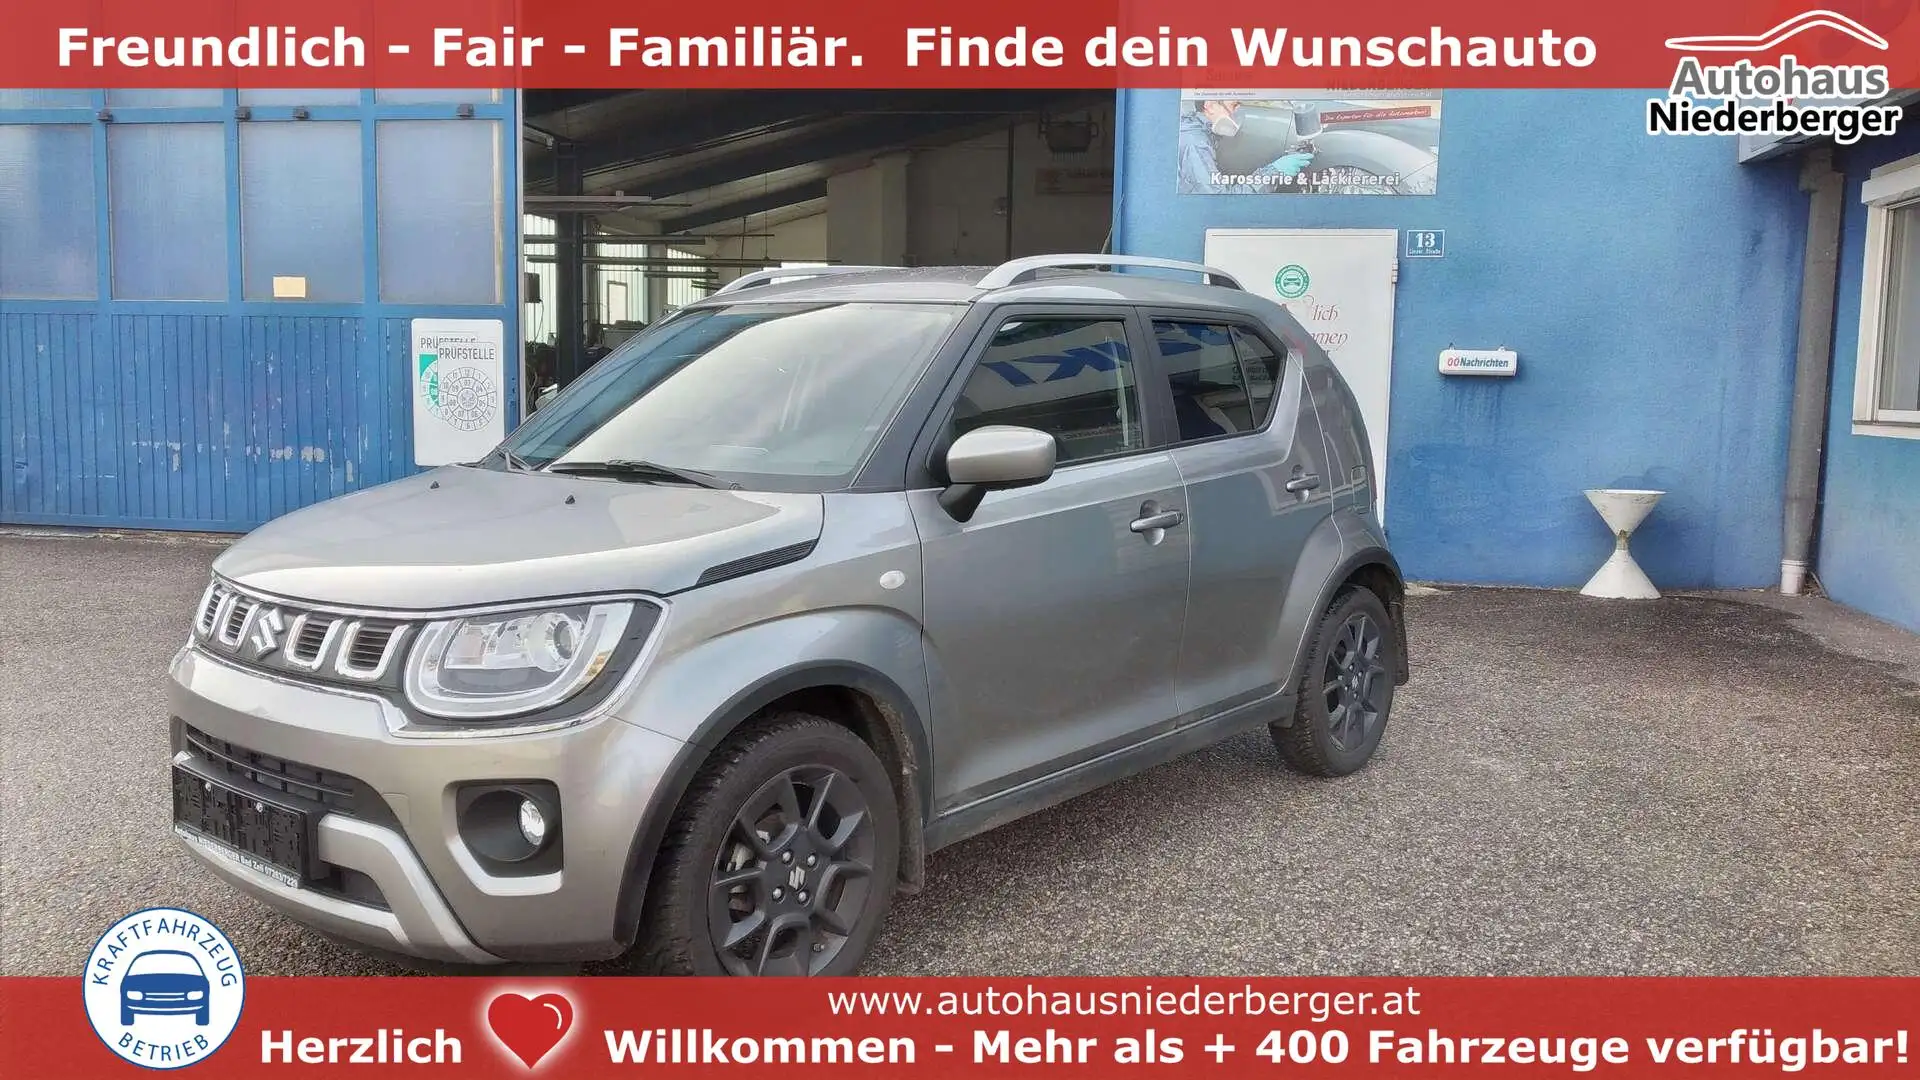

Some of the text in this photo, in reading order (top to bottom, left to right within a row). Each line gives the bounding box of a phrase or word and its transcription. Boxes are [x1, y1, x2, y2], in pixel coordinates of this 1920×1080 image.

[1210, 172, 1400, 186] Karosserie & Lackiererei
[1416, 232, 1436, 248] 13
